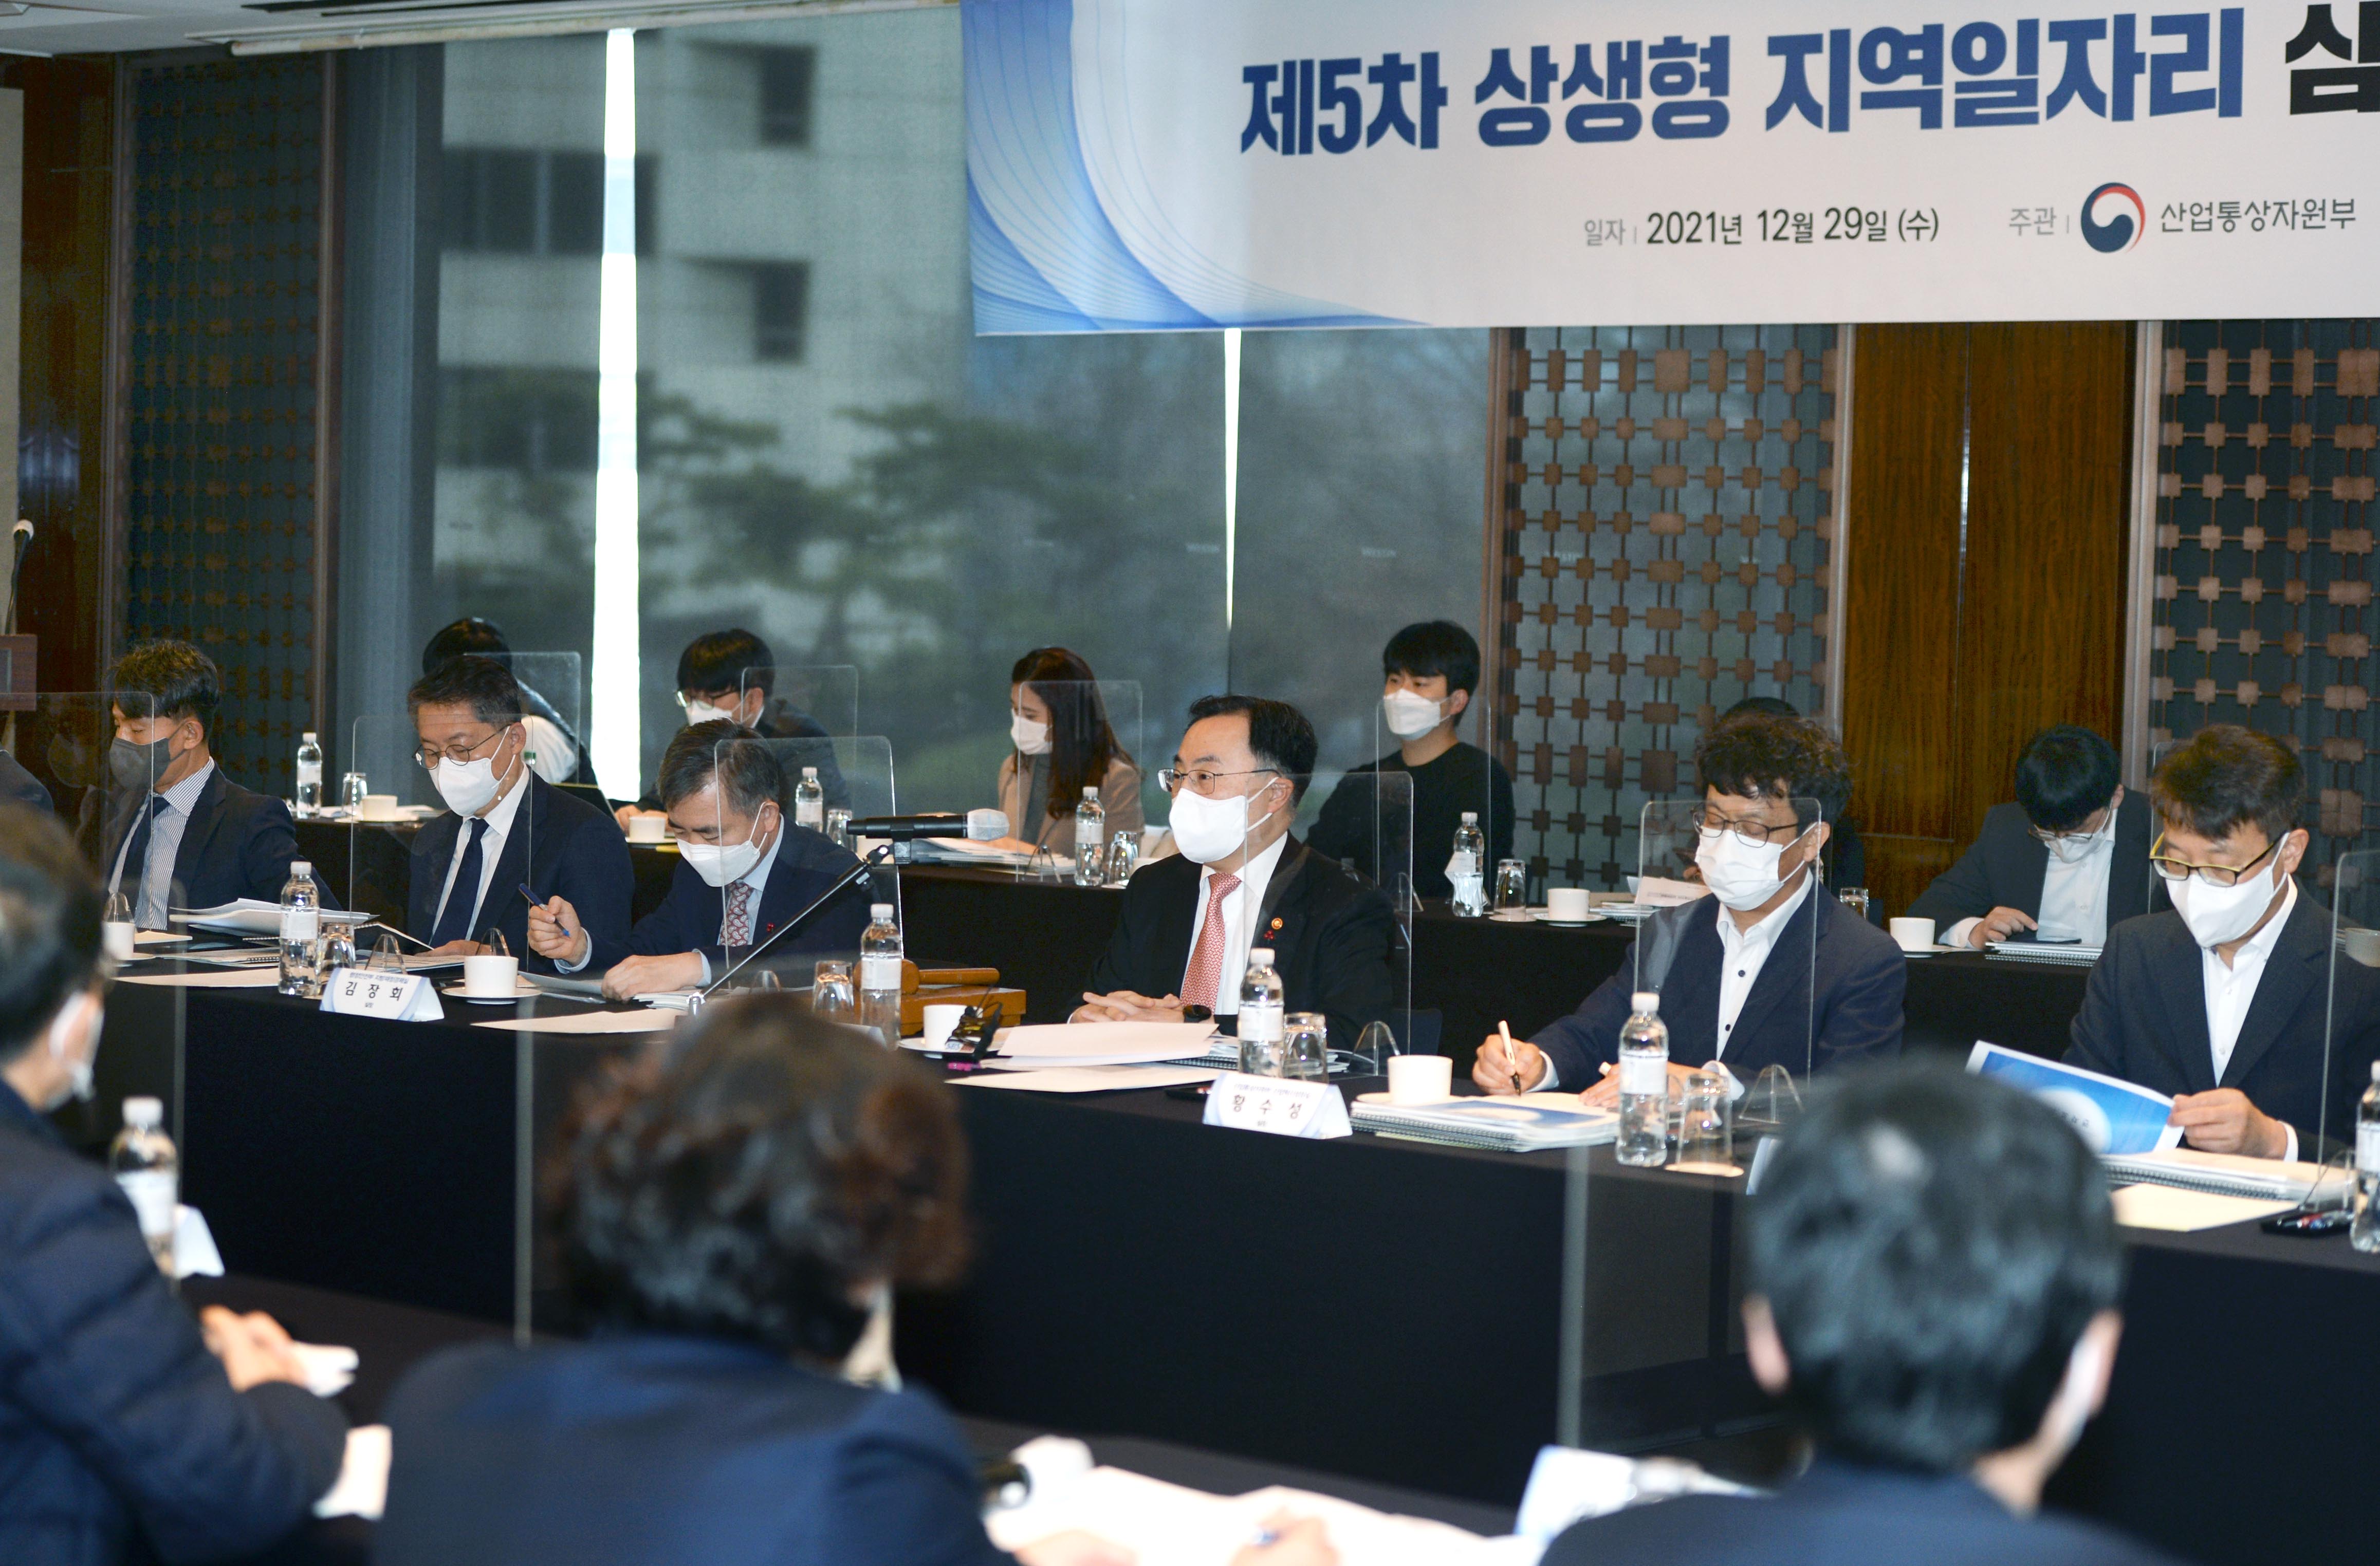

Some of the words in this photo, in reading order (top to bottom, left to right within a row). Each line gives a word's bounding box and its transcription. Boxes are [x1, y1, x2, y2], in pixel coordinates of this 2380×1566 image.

[1241, 52, 1449, 156] 제5차
[1475, 35, 1730, 147] 상생형
[1766, 8, 2244, 133] 지역일자리
[2285, 1, 2380, 116] 심
[1584, 218, 1627, 247] 일자
[1647, 211, 1742, 245] 2021년
[1757, 209, 1814, 244] 12월
[1824, 207, 1887, 243] 29일
[1898, 208, 1940, 243] (수)
[2008, 207, 2057, 236] 주관
[2161, 199, 2356, 234] 산업통상자원부
